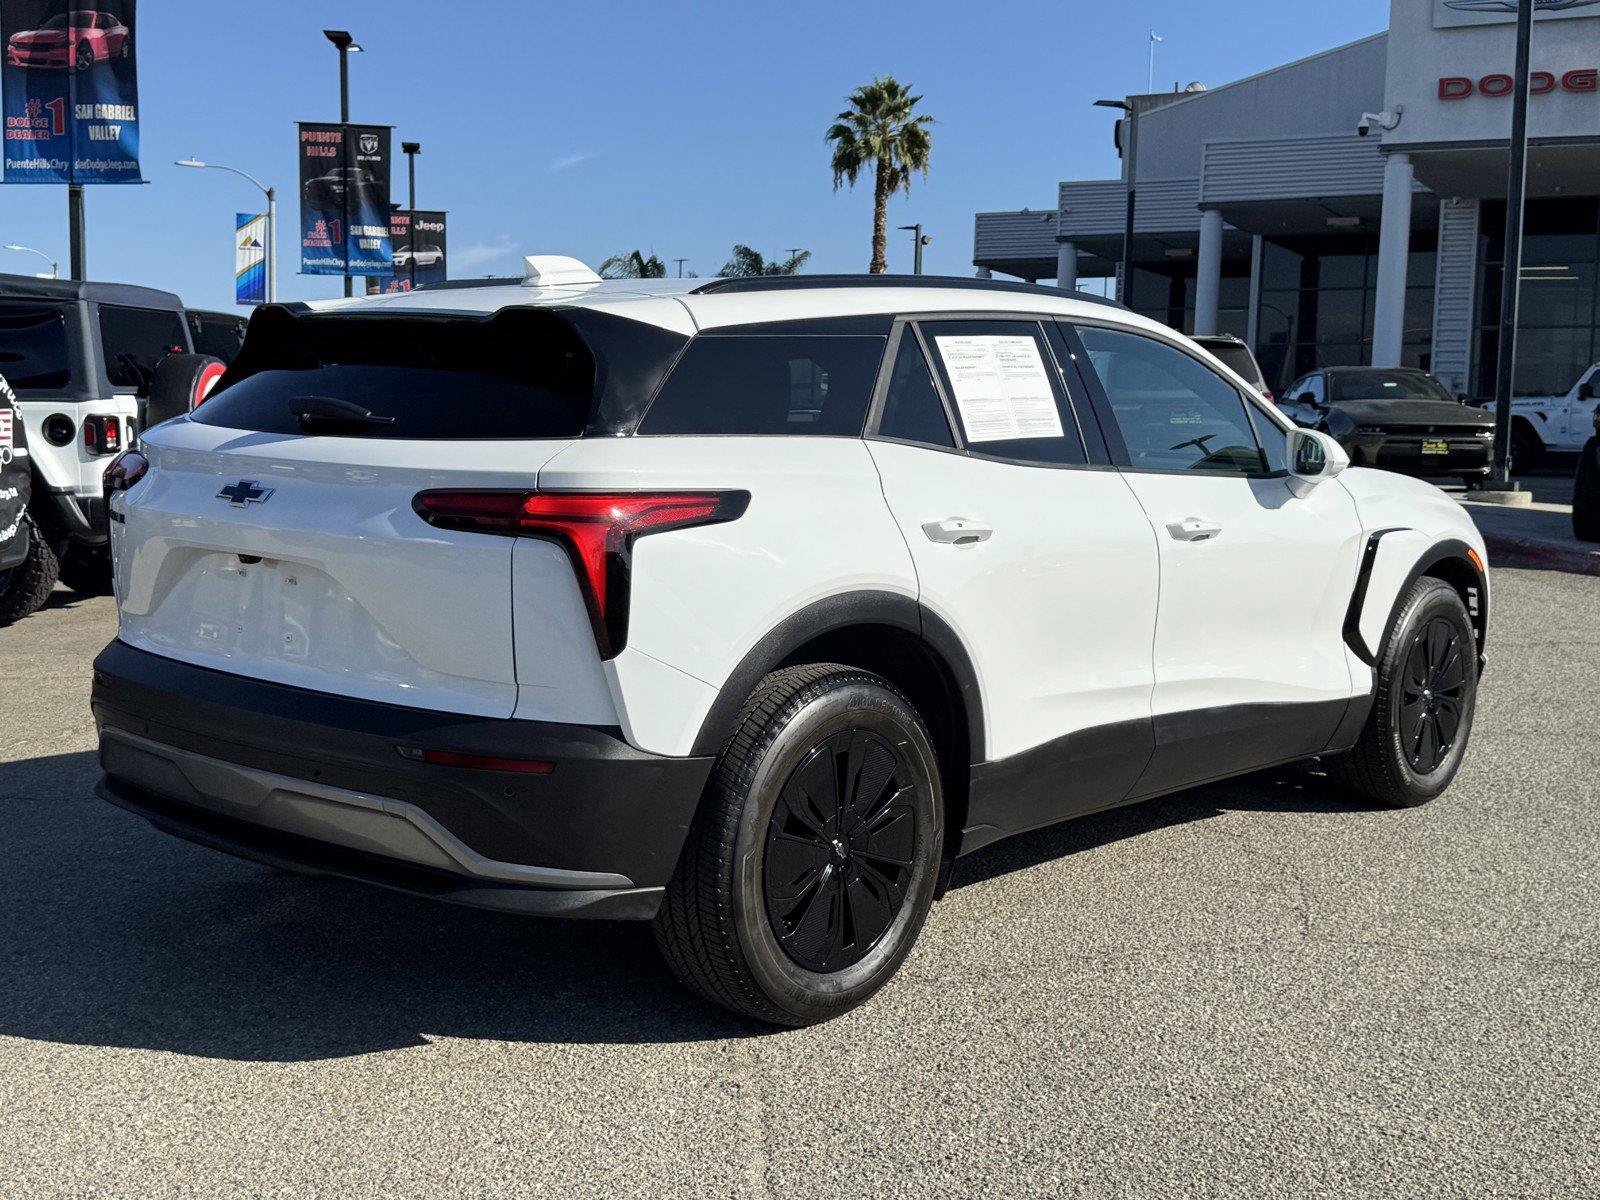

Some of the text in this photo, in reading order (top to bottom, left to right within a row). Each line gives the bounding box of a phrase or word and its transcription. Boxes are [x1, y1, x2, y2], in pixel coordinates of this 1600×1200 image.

[1438, 69, 1600, 99] DODG
[75, 104, 136, 121] SAN GABRIEL
[7, 117, 49, 128] DODGE
[6, 129, 50, 140] DEALER
[88, 125, 122, 141] VALLEY
[301, 131, 342, 143] PUENTE
[306, 146, 337, 157] HILLS
[415, 220, 444, 232] Jeep
[359, 239, 381, 250] VALLEY
